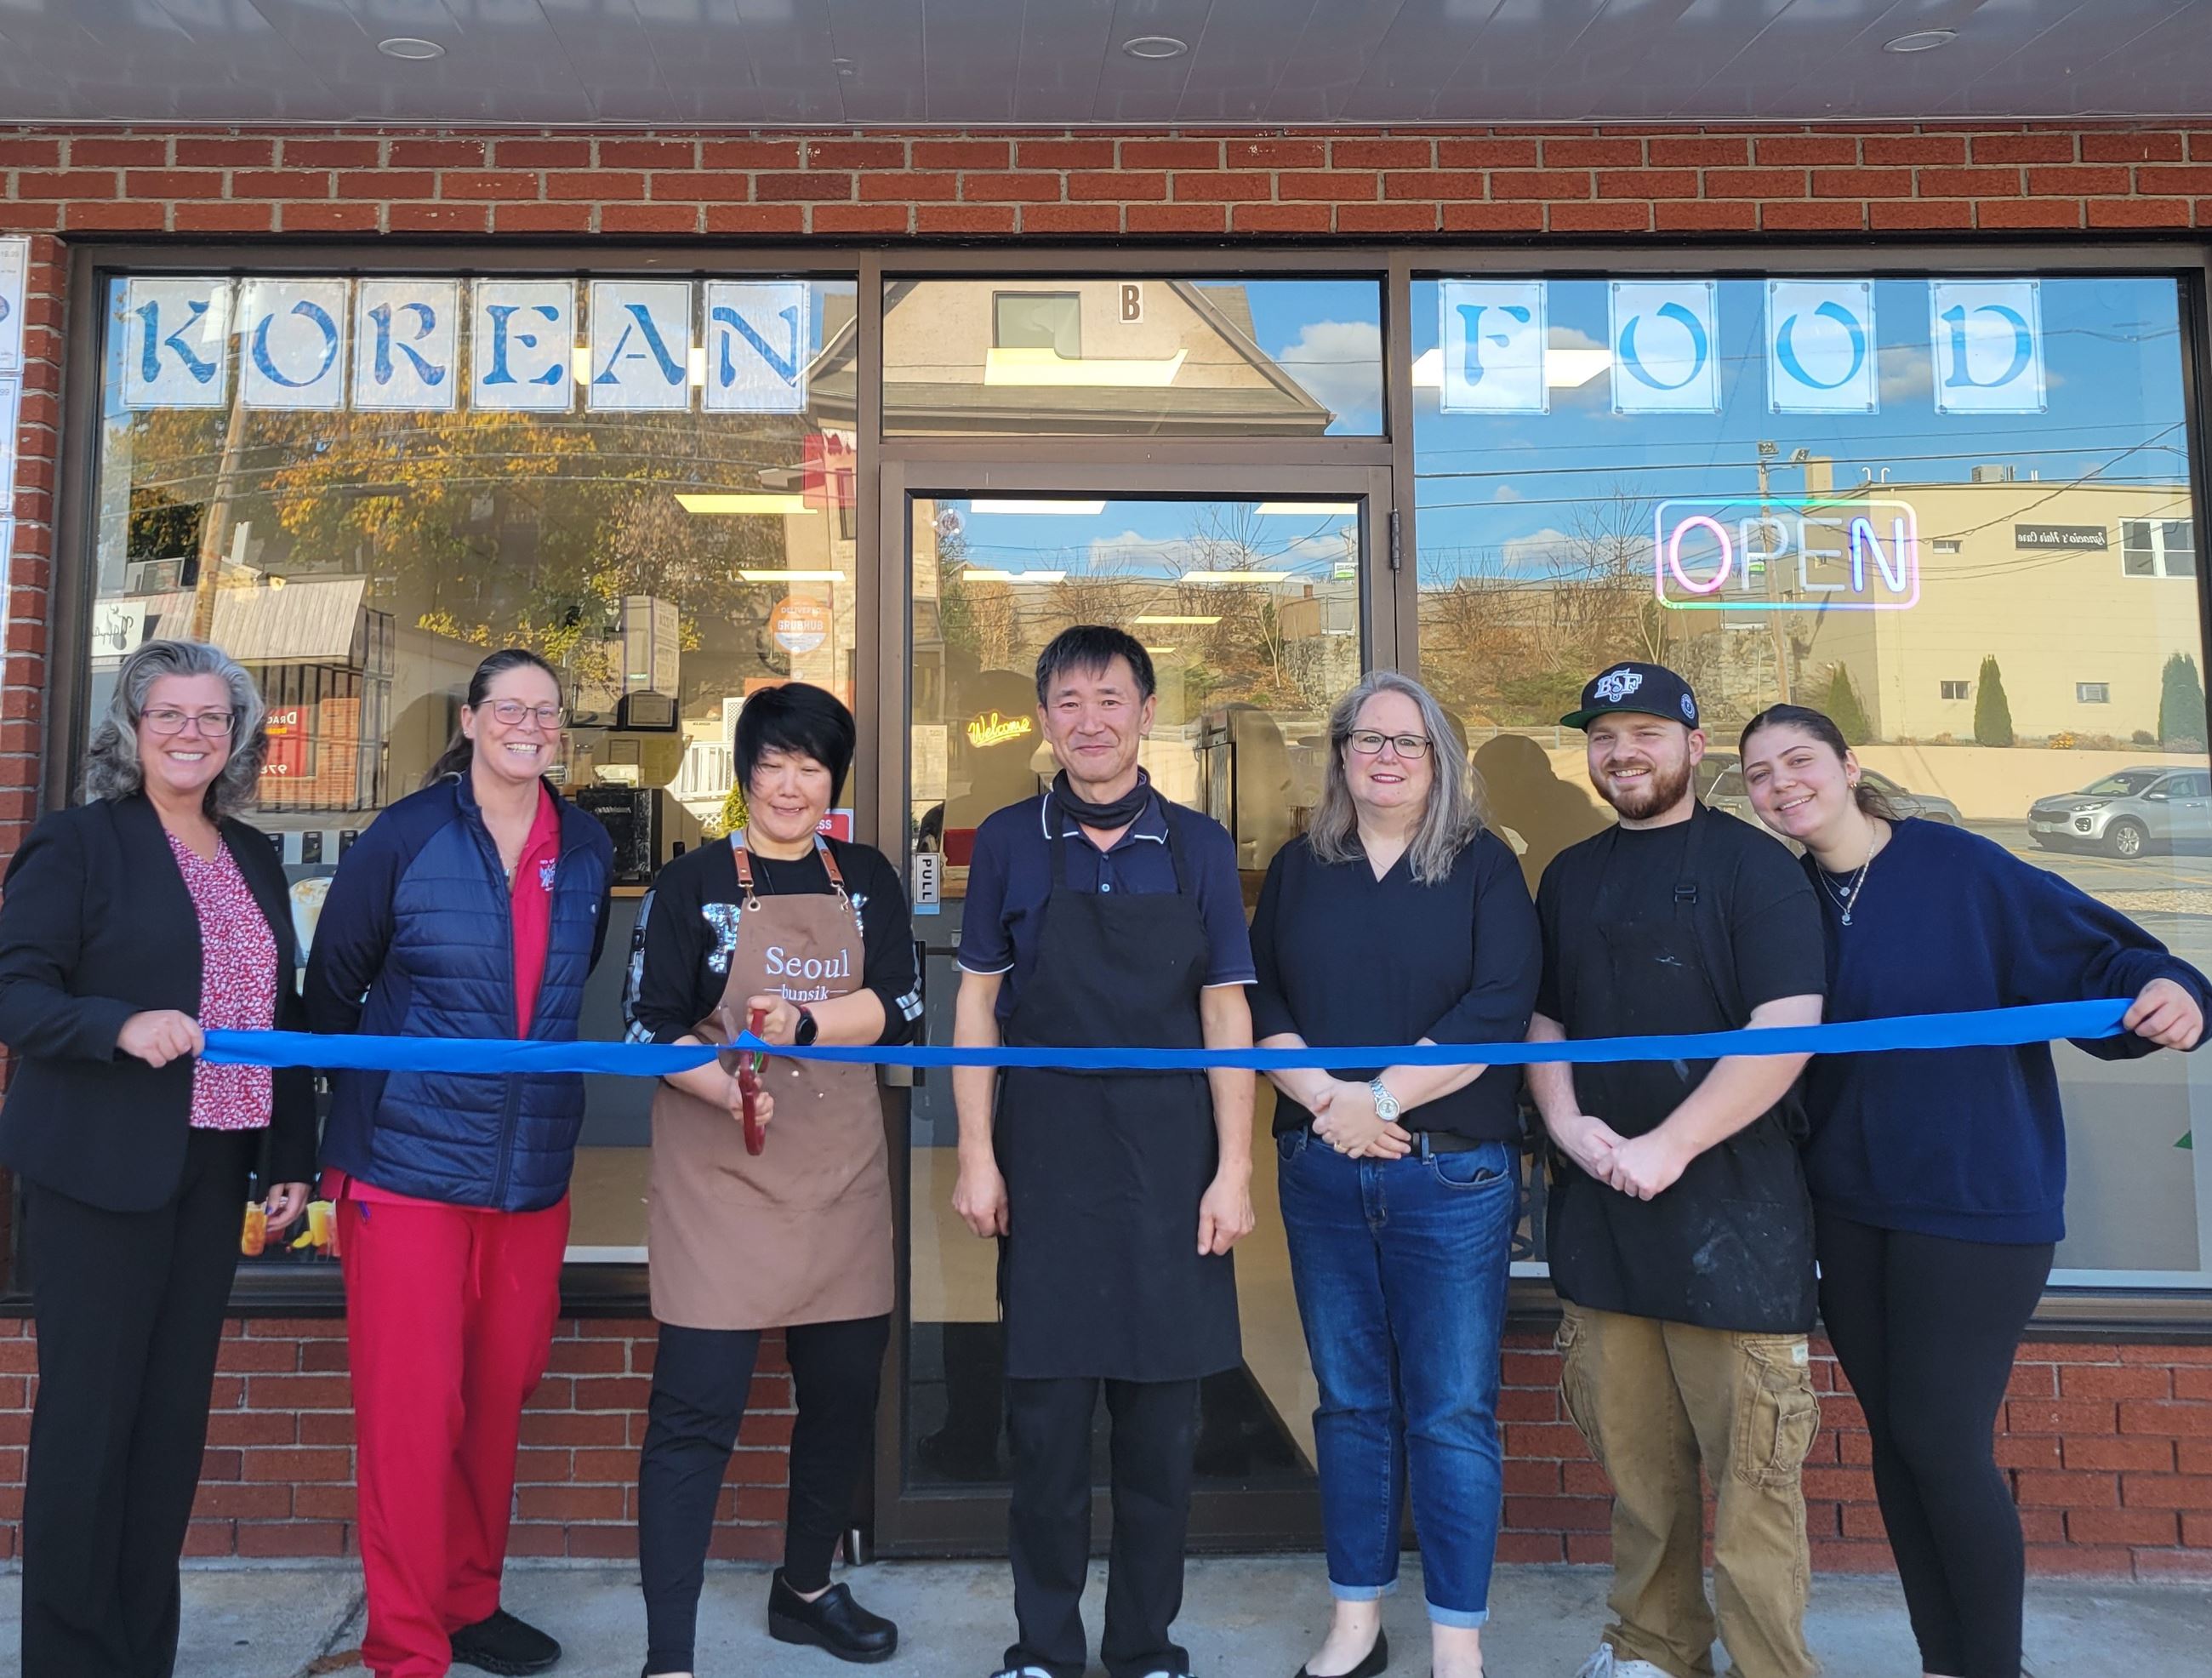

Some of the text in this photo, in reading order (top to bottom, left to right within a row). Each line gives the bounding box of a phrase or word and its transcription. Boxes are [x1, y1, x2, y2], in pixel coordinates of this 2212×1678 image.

[1122, 285, 1140, 320] B
[135, 300, 799, 389] KOREAN
[1457, 301, 2032, 391] FOOD
[1669, 516, 1907, 593] OPEN
[778, 619, 824, 631] GRUBHUB
[968, 712, 1029, 743] Welcome
[922, 859, 932, 900] PULL
[766, 946, 851, 979] Seoul
[782, 984, 830, 1002] bunsik
